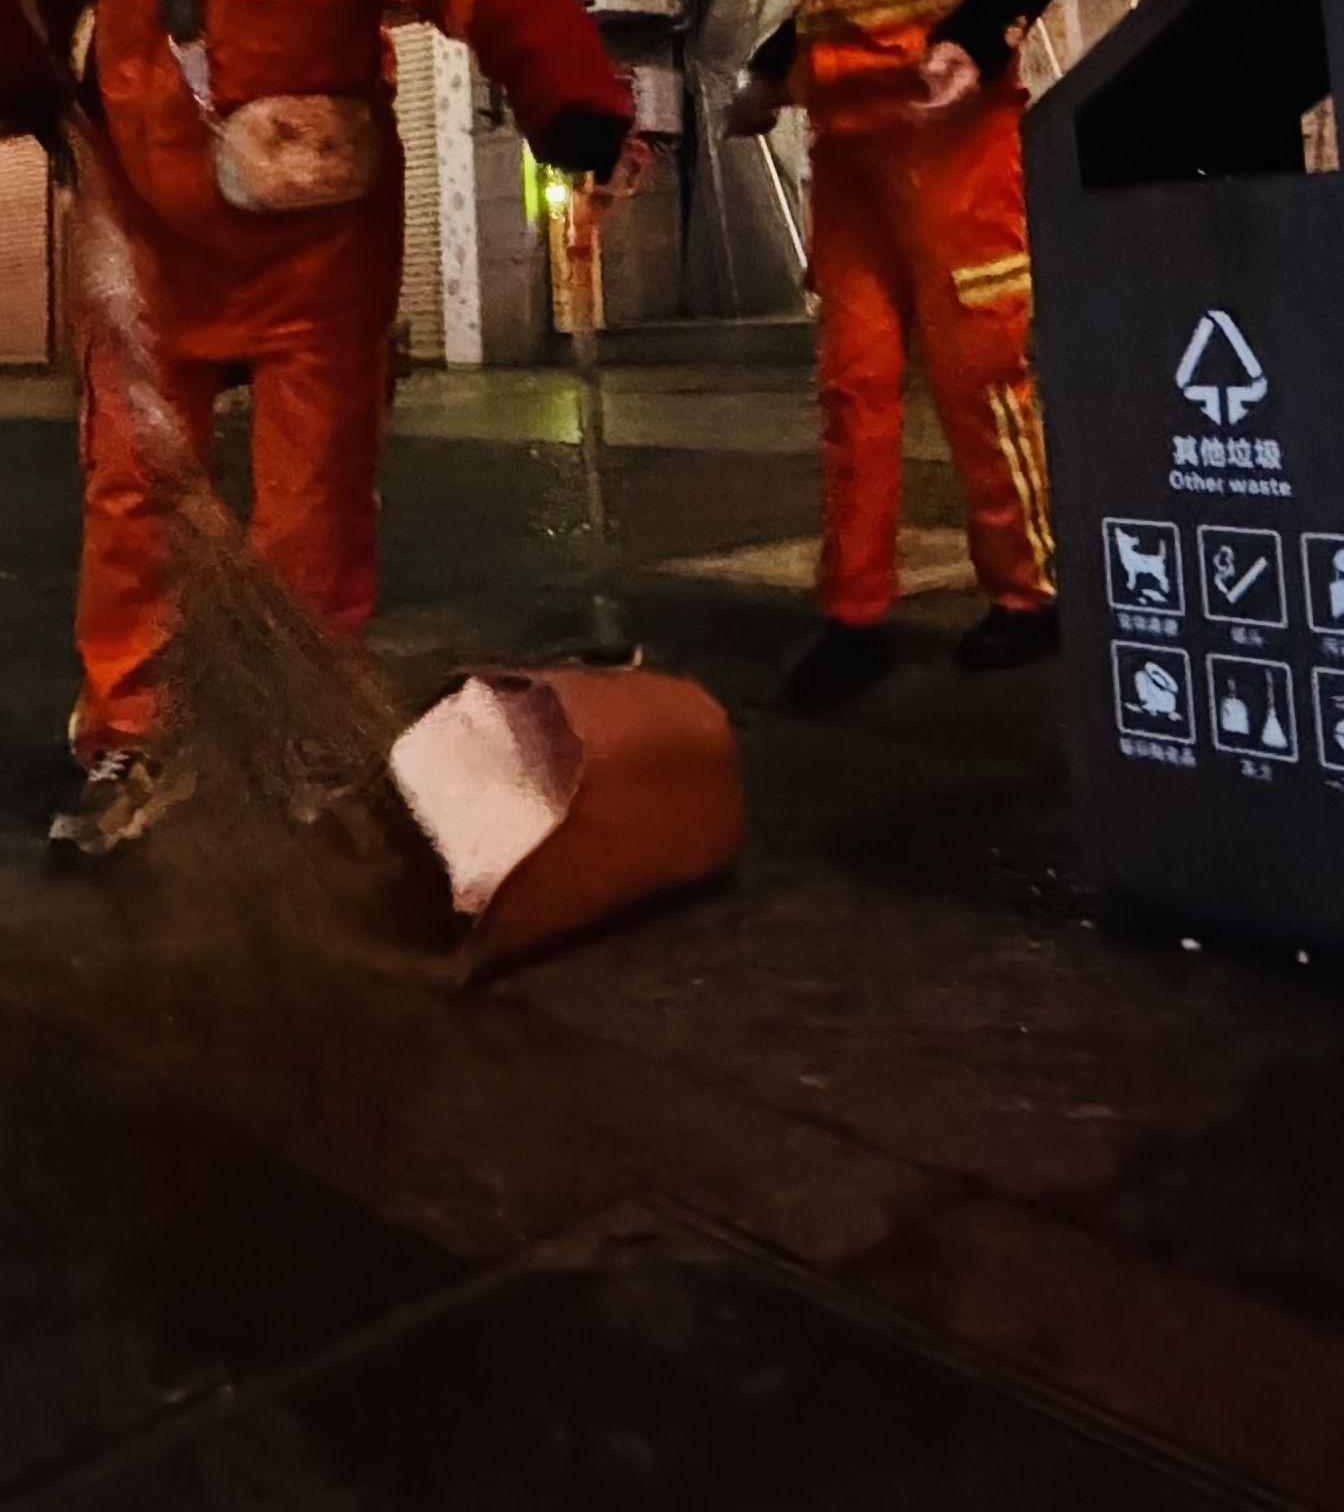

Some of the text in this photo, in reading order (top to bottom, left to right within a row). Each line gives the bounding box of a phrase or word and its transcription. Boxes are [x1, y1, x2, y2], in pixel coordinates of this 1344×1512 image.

[1171, 434, 1283, 470] 其他垃圾
[1168, 469, 1293, 497] Other waste
